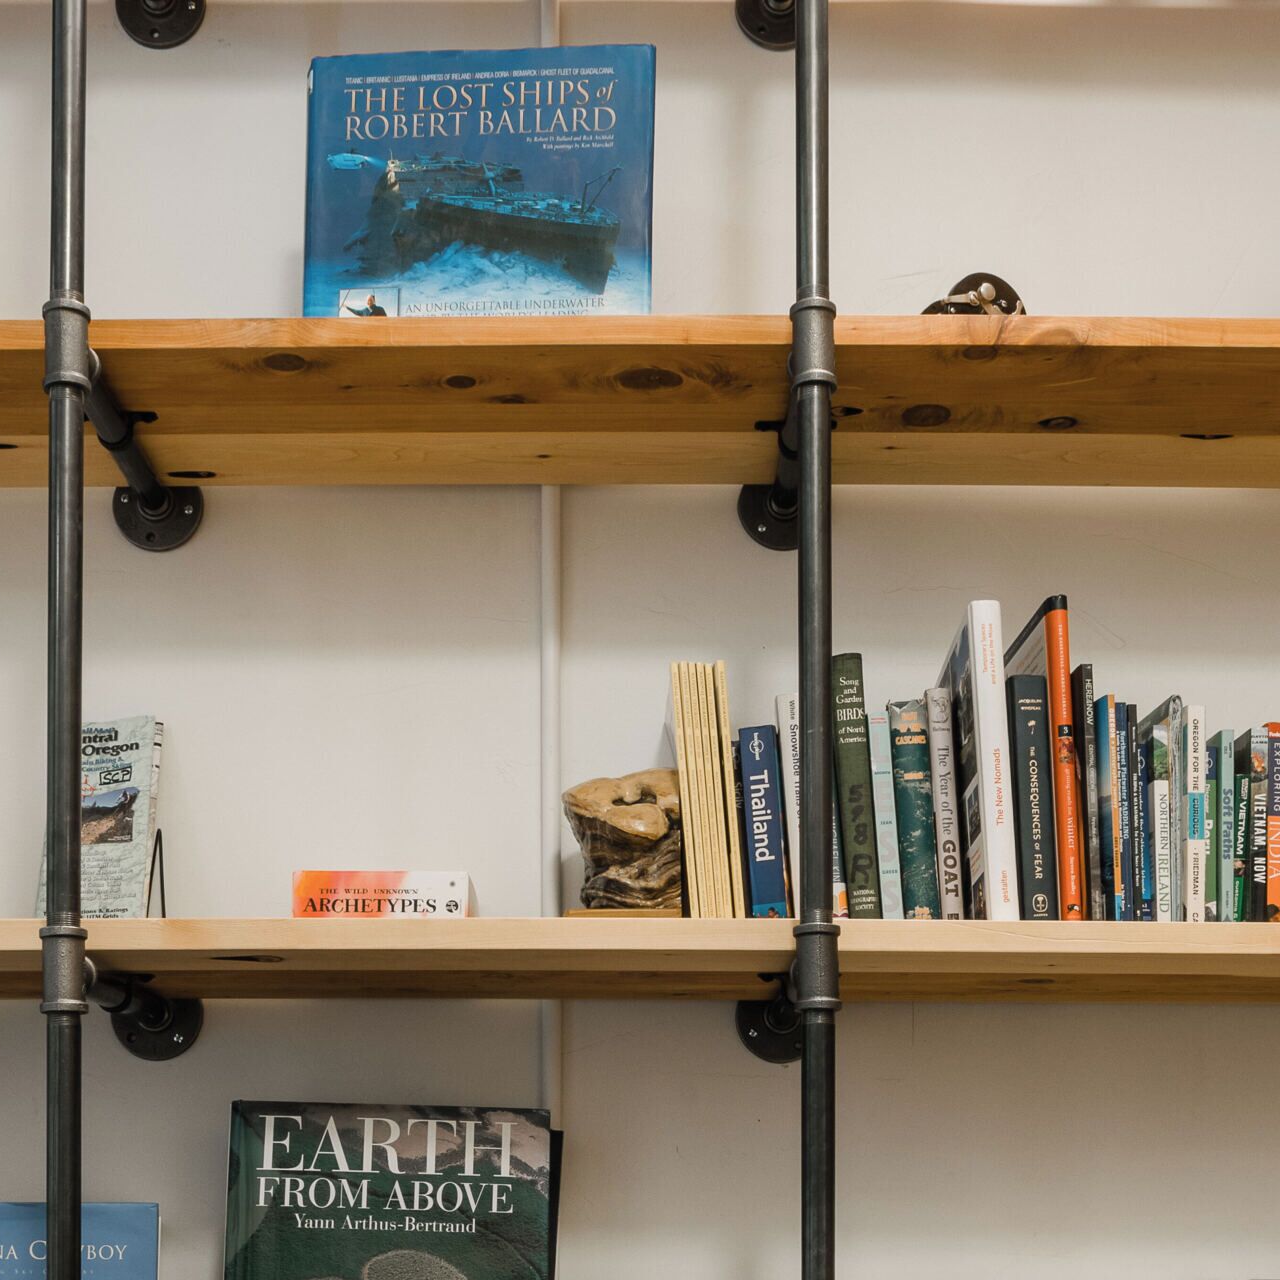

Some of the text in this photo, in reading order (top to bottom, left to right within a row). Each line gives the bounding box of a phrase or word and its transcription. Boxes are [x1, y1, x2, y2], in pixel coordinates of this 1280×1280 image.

[344, 79, 618, 113] THE LOST SHIPS of
[344, 107, 617, 141] ROBERT BALLARD
[405, 297, 605, 313] AN UNFORGETTABLE UNDERWATER
[839, 676, 860, 687] Song
[843, 687, 857, 695] and
[82, 742, 139, 757] Oregon
[993, 748, 1004, 826] The New Nomads
[749, 769, 775, 862] Thailand
[937, 745, 959, 897] The Year of the GOAT
[1223, 788, 1233, 860] Soft Paths
[1236, 801, 1247, 855] VIETNAM
[1158, 793, 1170, 913] NORTHERN IRELAND
[303, 898, 437, 914] ARCHETYPES
[256, 1114, 517, 1177] EARTH
[256, 1177, 514, 1214] FROM ABOVE
[294, 1213, 476, 1234] Yann Arthus-Bertrand
[29, 1240, 128, 1261] CBOY
